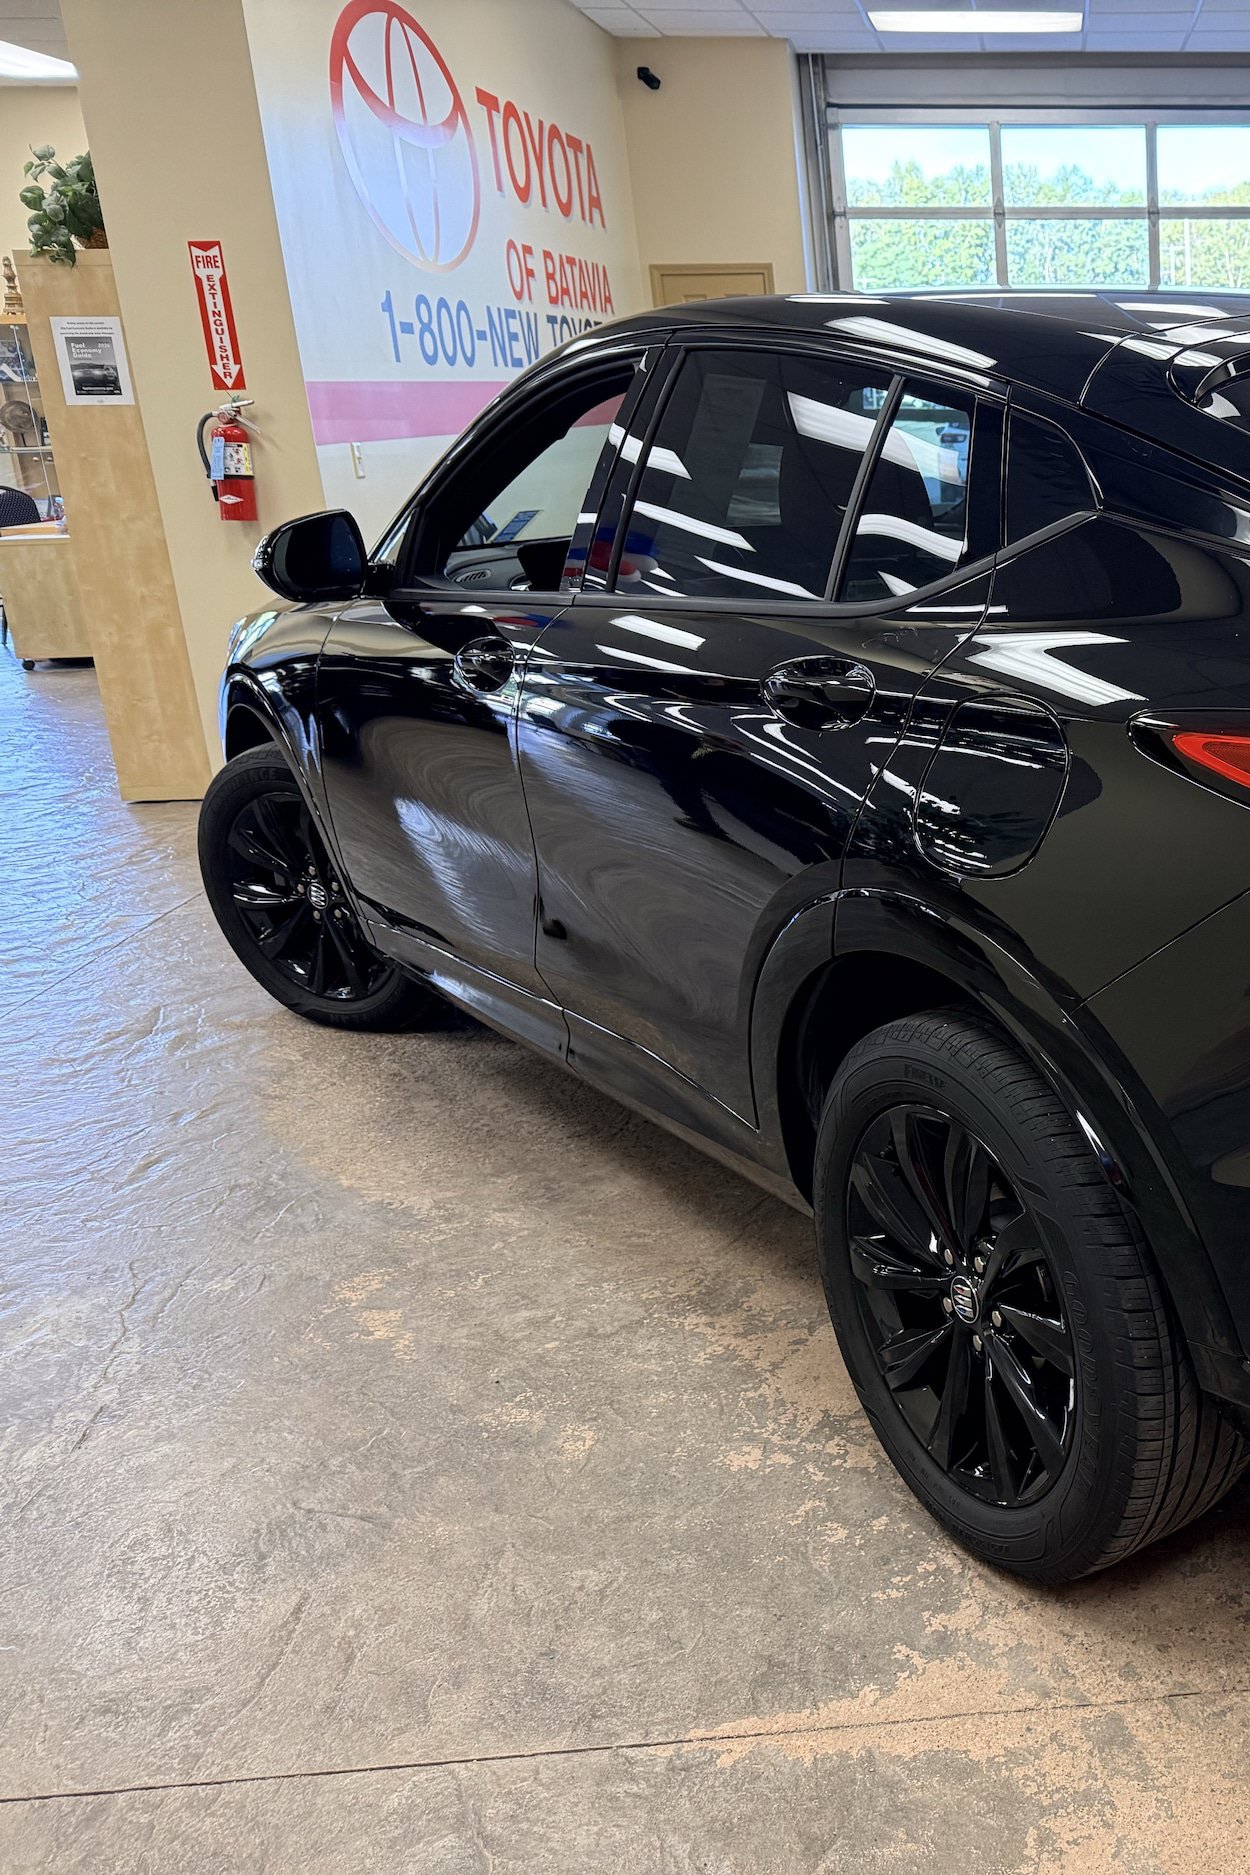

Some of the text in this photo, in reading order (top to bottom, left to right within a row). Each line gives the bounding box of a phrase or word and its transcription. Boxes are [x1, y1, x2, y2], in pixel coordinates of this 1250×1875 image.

[475, 86, 606, 230] TOYOTA
[195, 255, 220, 269] FIRE
[506, 238, 615, 315] OF BATAVIA
[206, 274, 233, 379] EXTINGUISHER
[380, 289, 540, 368] 1-800-NEW
